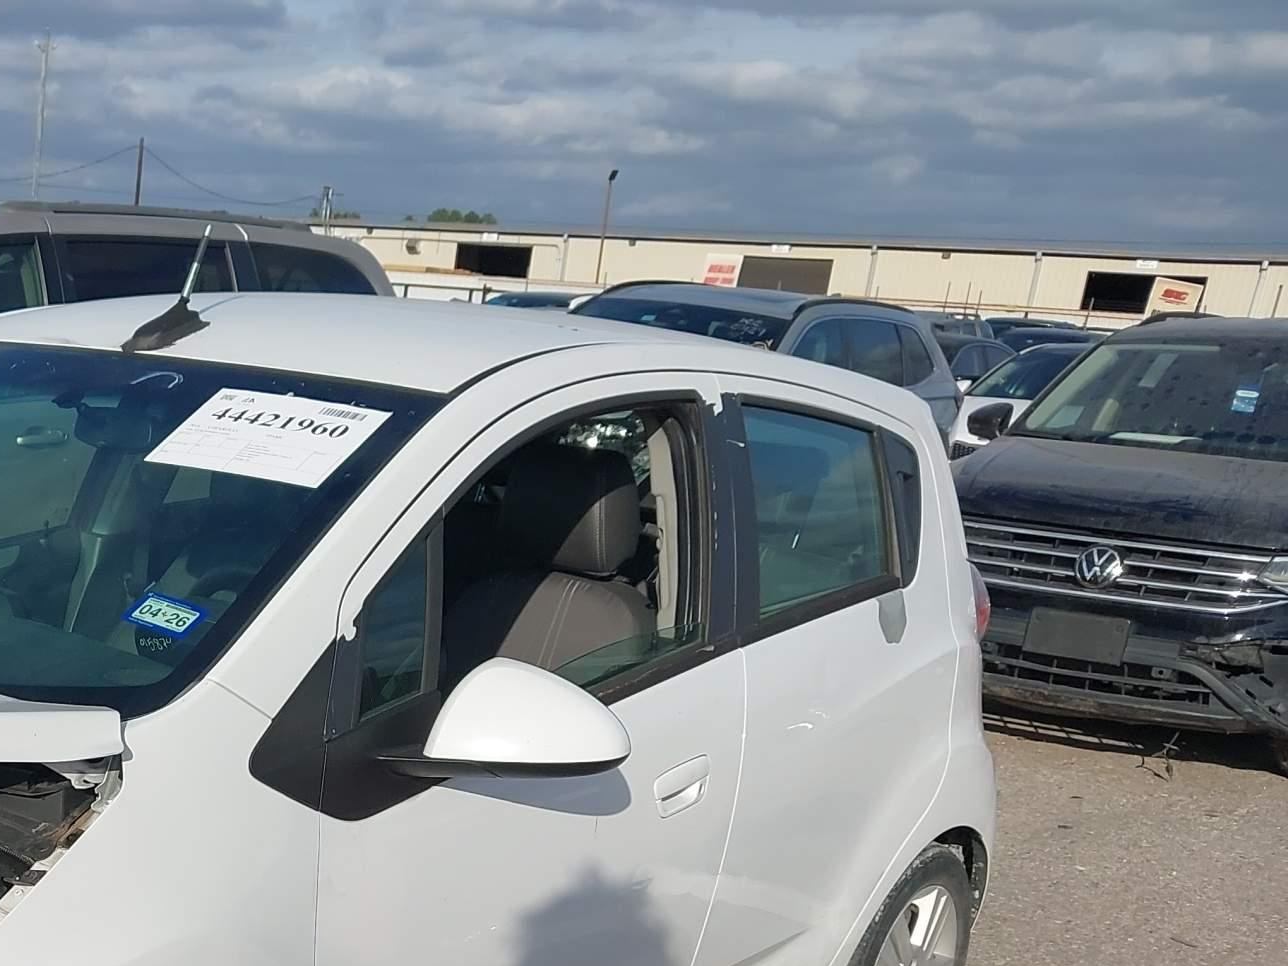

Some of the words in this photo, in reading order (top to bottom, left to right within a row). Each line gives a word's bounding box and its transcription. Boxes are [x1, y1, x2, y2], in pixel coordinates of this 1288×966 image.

[212, 407, 350, 440] 44421960
[138, 604, 163, 618] 04
[164, 612, 191, 628] 26
